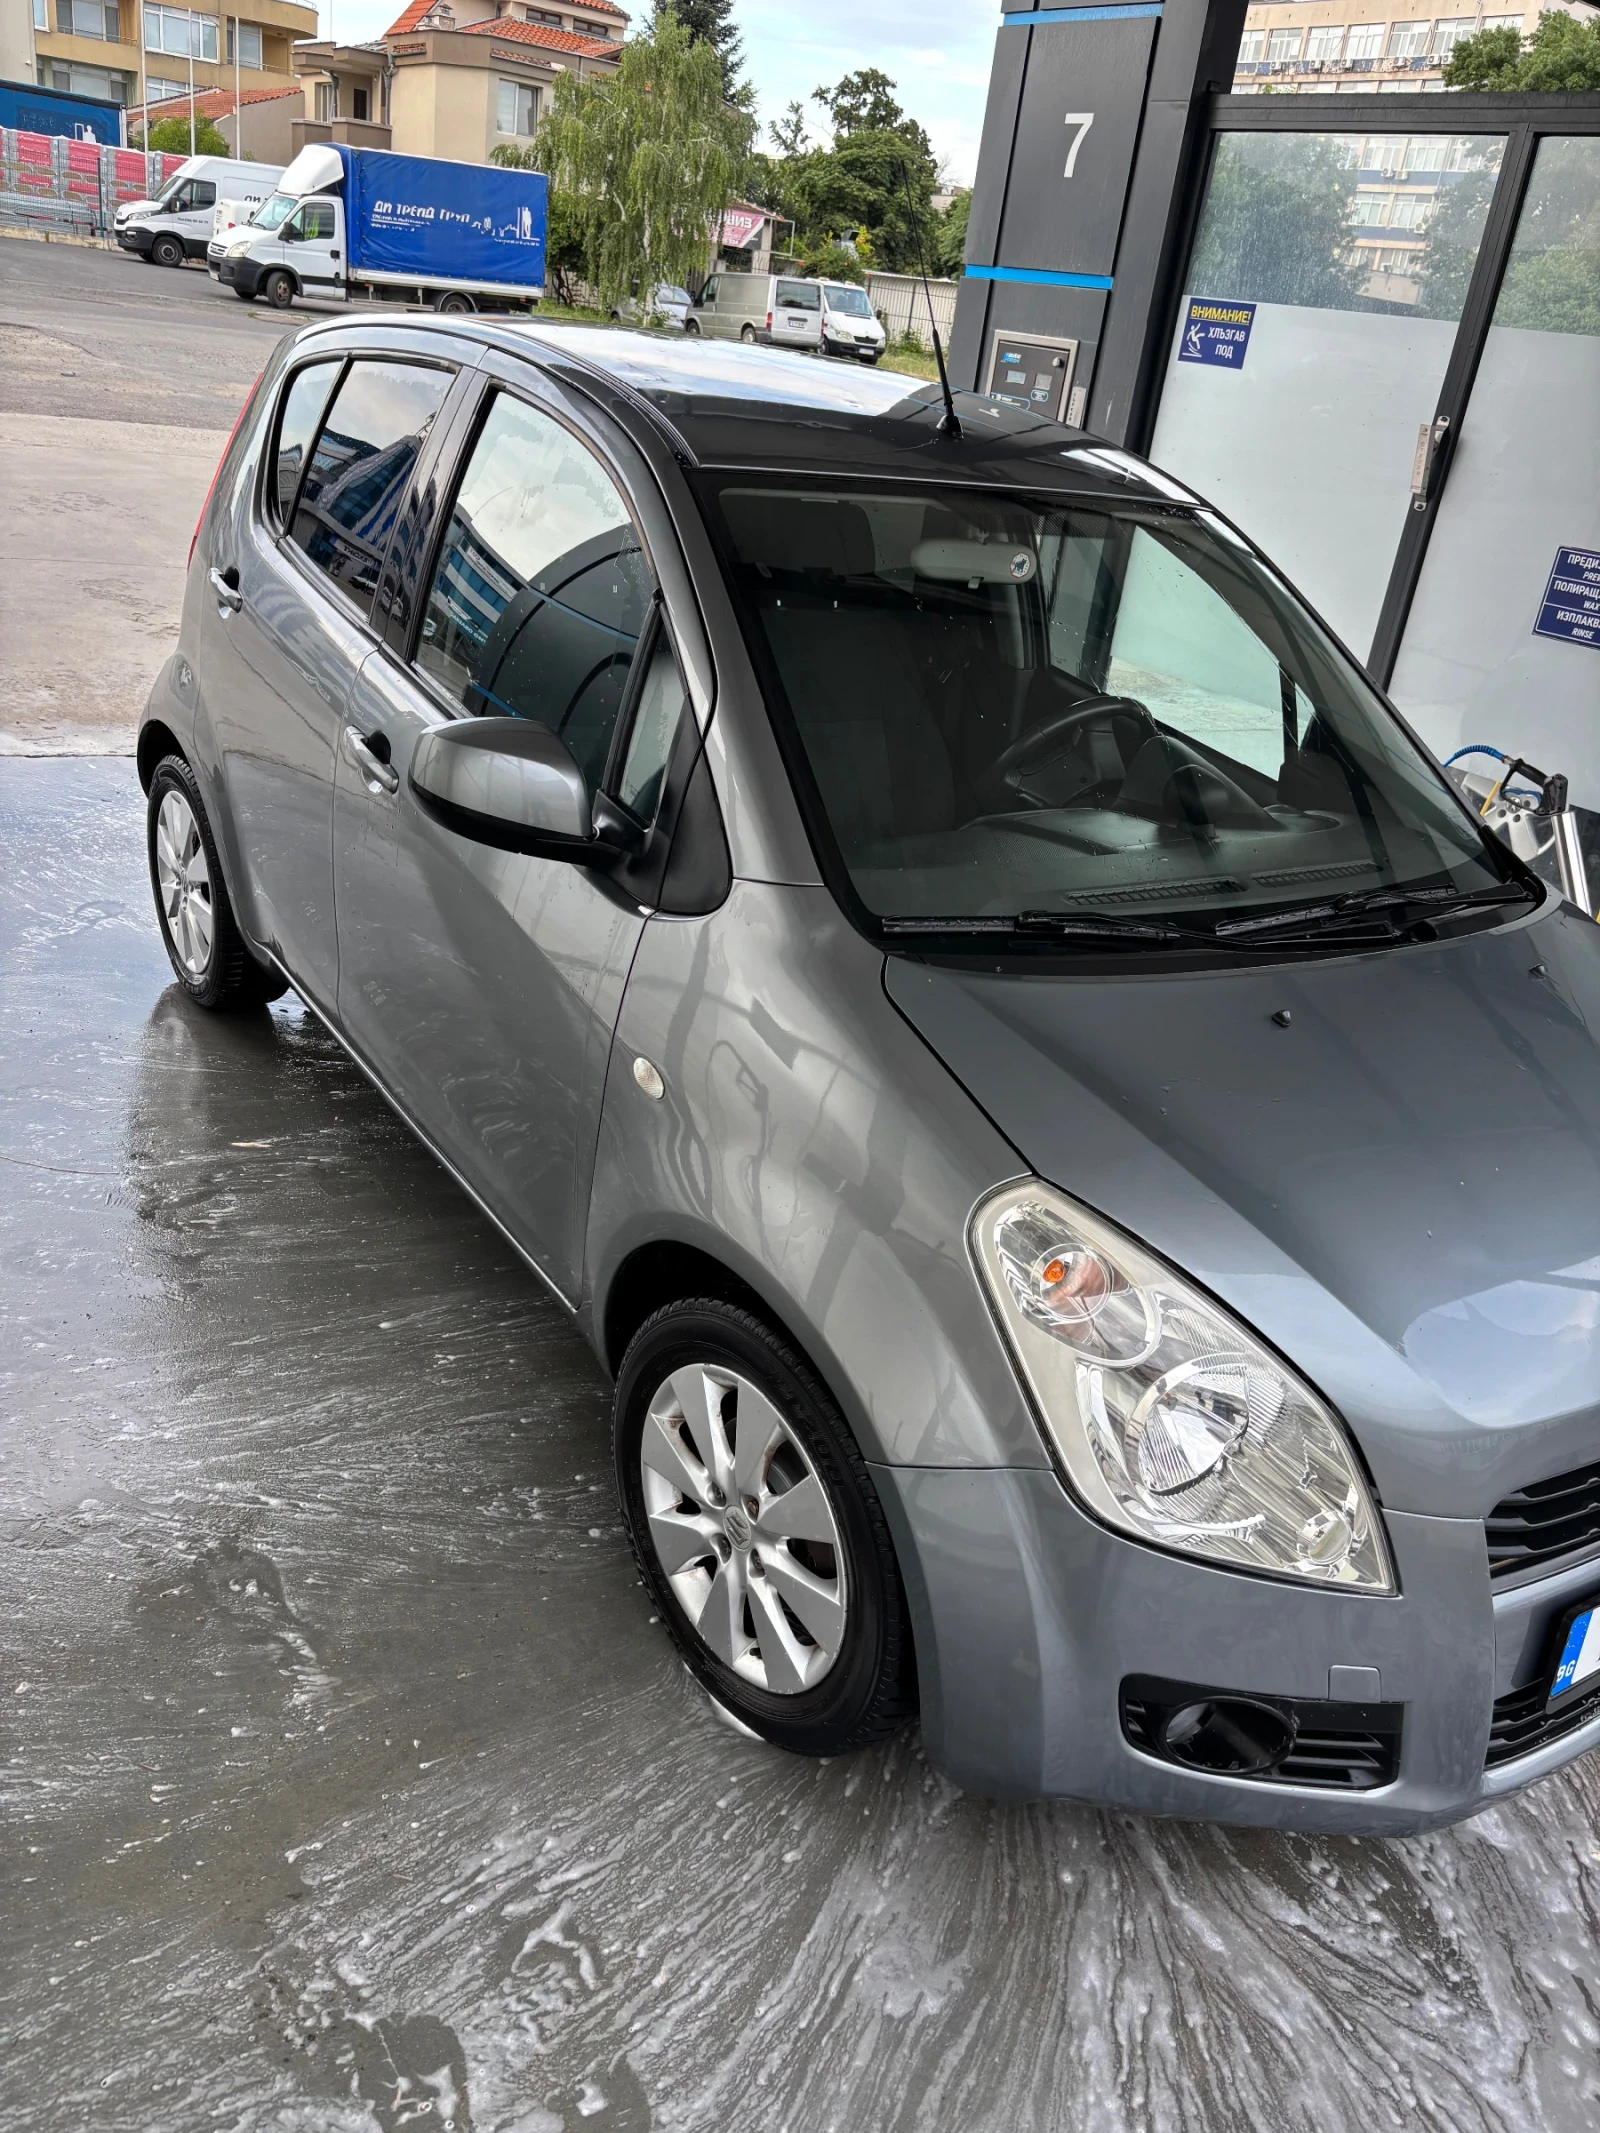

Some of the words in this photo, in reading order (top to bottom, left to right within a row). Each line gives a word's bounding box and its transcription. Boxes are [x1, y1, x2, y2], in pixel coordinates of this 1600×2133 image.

[1063, 112, 1095, 178] 7
[1190, 305, 1252, 324] ВНИМАНИЕ!
[1207, 326, 1246, 342] ХЛЪЗГАВ
[1214, 344, 1234, 359] ПОД
[1553, 580, 1600, 600] ПОЛИРАЩ
[1583, 600, 1600, 611] WAX
[1556, 610, 1600, 629] ИЗПЛАКВ
[1571, 627, 1595, 640] RINSE
[1556, 1660, 1576, 1683] BG
